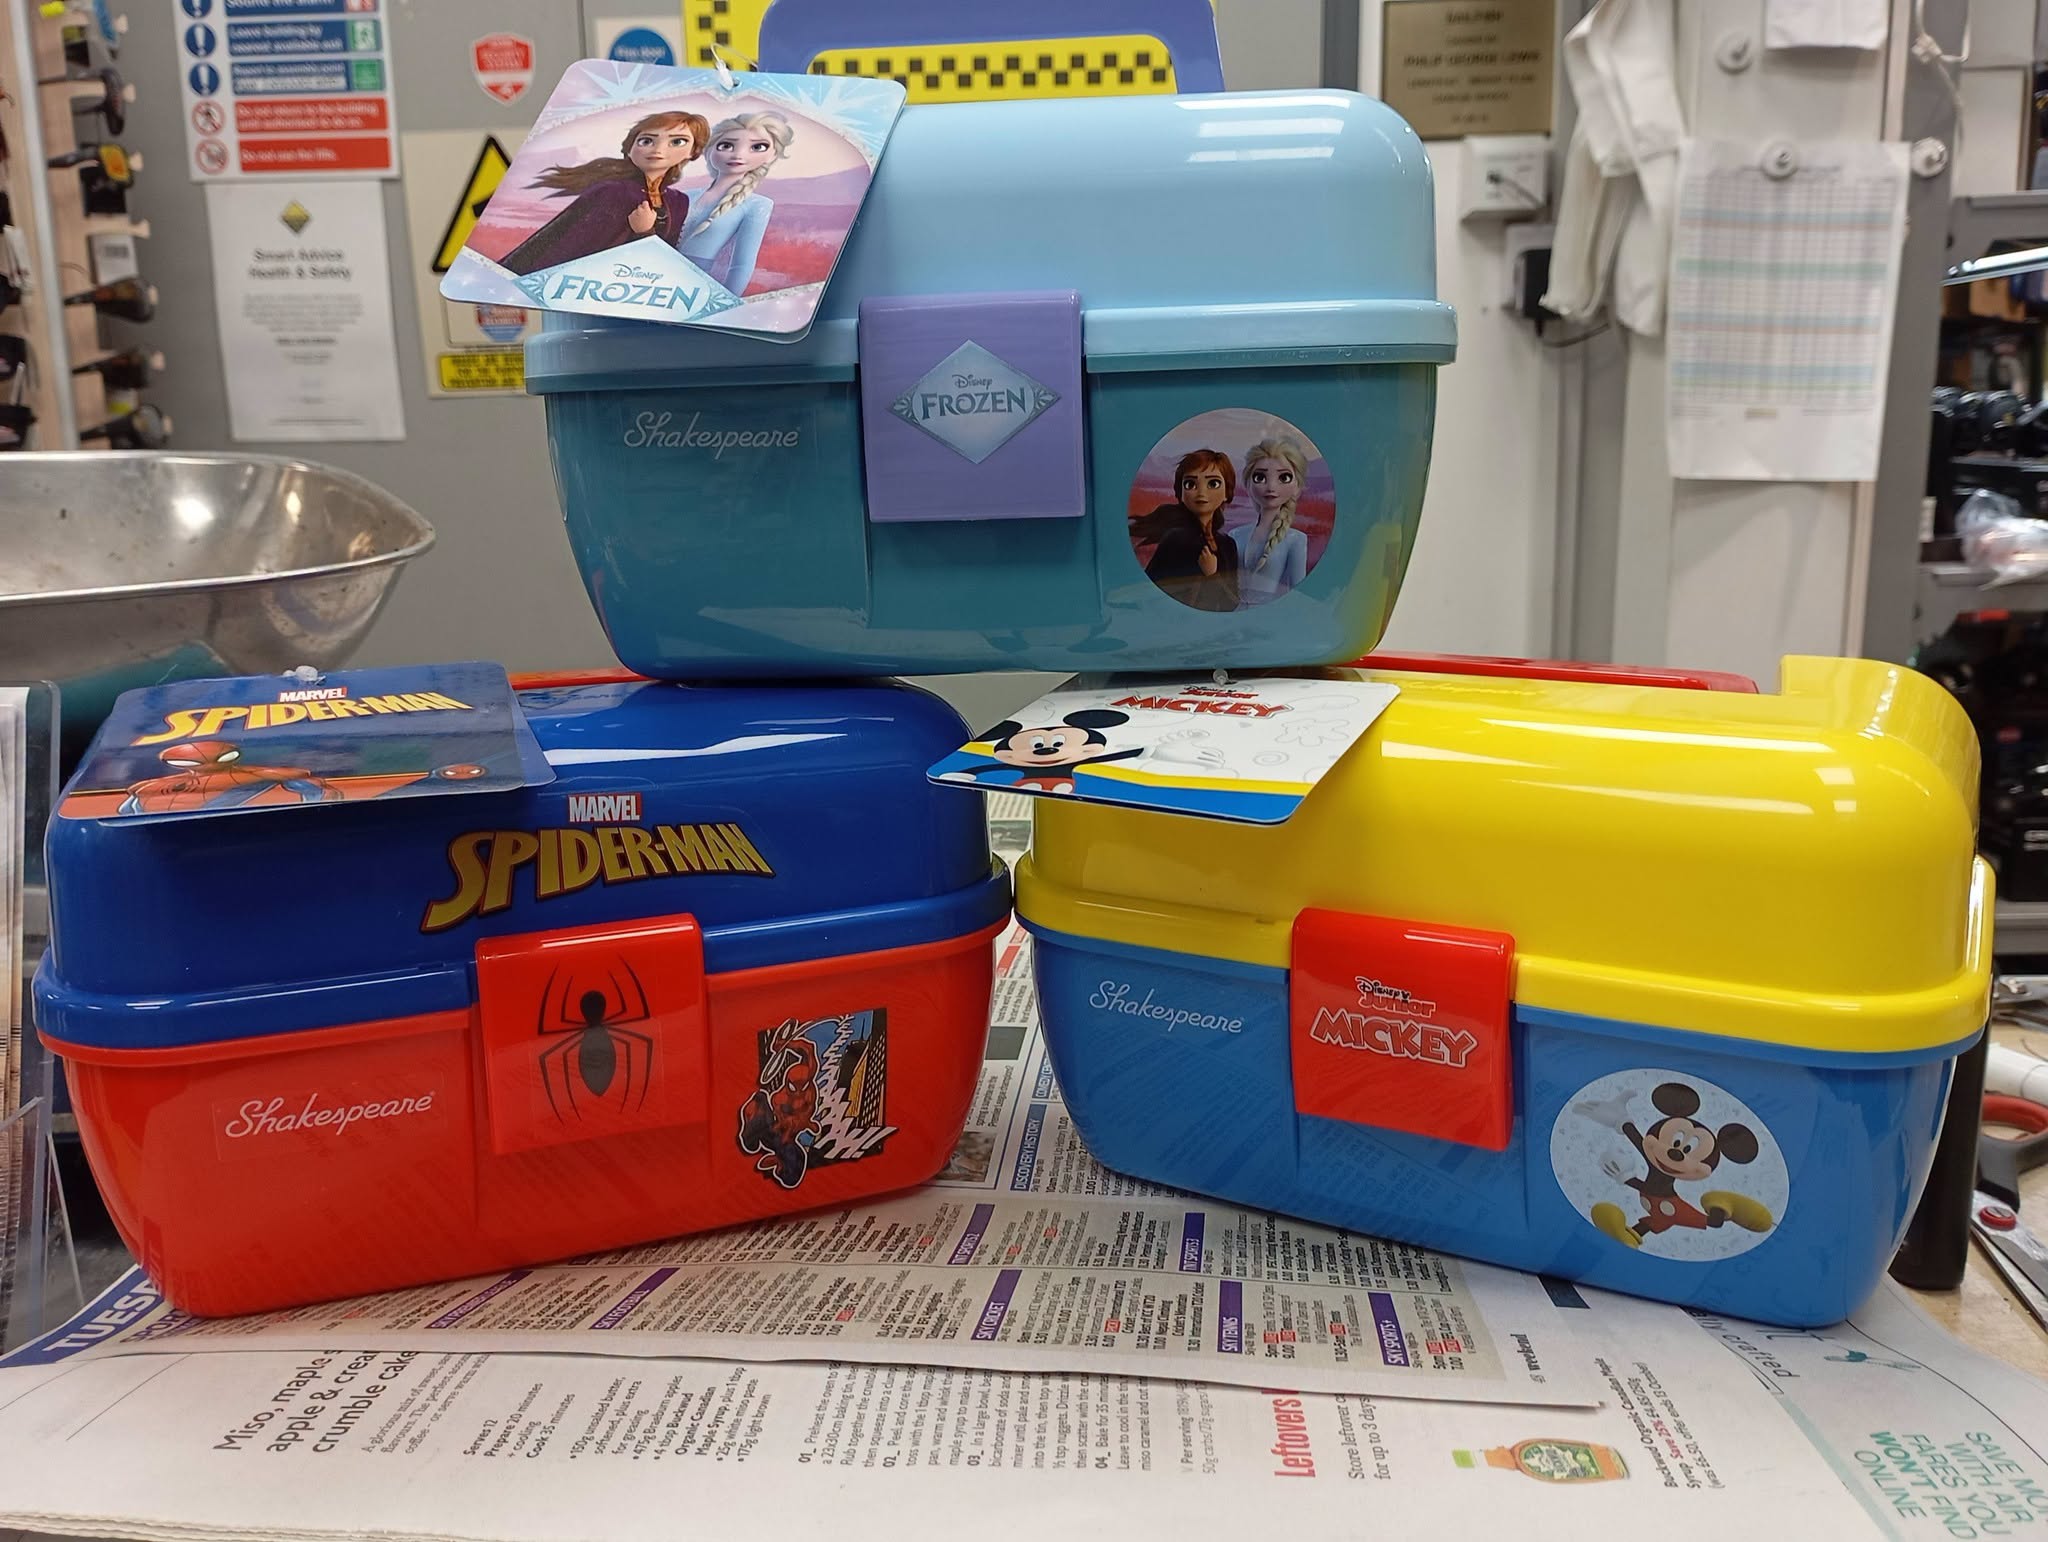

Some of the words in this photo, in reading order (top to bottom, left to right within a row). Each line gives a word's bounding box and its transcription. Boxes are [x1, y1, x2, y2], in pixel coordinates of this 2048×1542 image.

[254, 247, 293, 261] Smart
[249, 266, 290, 279] Health
[310, 266, 351, 281] Safety
[551, 275, 701, 313] FROZEN
[921, 386, 1027, 420] FROZEN
[624, 411, 799, 460] Shakespeare
[280, 687, 345, 703] MARVEL
[1110, 695, 1292, 718] MICKEY
[133, 692, 473, 747] SPIDER-MAN
[569, 794, 641, 822] MARVEL
[421, 823, 775, 932] SPIDER-MAN
[1089, 980, 1243, 1034] Shakespeare
[1310, 1008, 1478, 1068] MICKEY
[225, 1093, 434, 1138] Shakespeare
[1013, 1147, 1034, 1190] DISCOVERY
[1024, 1119, 1041, 1148] HISTORY
[982, 1302, 1005, 1326] CRICKET
[1222, 1317, 1238, 1337] TENNIS
[976, 1325, 995, 1339] SKY
[1222, 1337, 1238, 1351] SKY
[1386, 1348, 1404, 1364] SKY
[1594, 1358, 1614, 1377] Maple
[1723, 1333, 1801, 1379] crafted
[664, 1375, 683, 1398] apples
[743, 1379, 759, 1398] paste
[900, 1380, 914, 1391] the
[1608, 1378, 1635, 1410] Canadian
[213, 1406, 285, 1451] Miso,
[273, 1357, 333, 1403] maple
[312, 1385, 387, 1452] crumble
[378, 1350, 421, 1380] cake
[570, 1436, 595, 1453] 150g
[585, 1403, 610, 1435] unsalted
[600, 1377, 626, 1401] butter,
[666, 1393, 694, 1428] Buckwud
[695, 1429, 717, 1456] Maple
[707, 1404, 730, 1428] Syrup,
[720, 1387, 735, 1402] plus
[729, 1367, 747, 1382] tbsp
[735, 1399, 750, 1416] miso
[751, 1394, 771, 1418] brown
[804, 1413, 825, 1444] Preheat
[816, 1399, 830, 1411] the
[823, 1380, 835, 1397] oven
[899, 1393, 910, 1409] core
[1096, 1404, 1109, 1413] 35
[1354, 1396, 1376, 1421] days
[1660, 1399, 1680, 1418] ends
[266, 1405, 326, 1452] apple
[309, 1388, 343, 1400] &
[483, 1425, 515, 1457] Prepare
[506, 1413, 522, 1424] 20
[517, 1383, 543, 1412] minutes
[526, 1436, 549, 1458] Cook
[550, 1394, 575, 1424] minutes
[594, 1418, 623, 1454] softened,
[614, 1401, 631, 1416] plus
[625, 1381, 642, 1400] extra
[611, 1442, 628, 1454] for
[622, 1409, 650, 1441] greasing
[642, 1399, 670, 1434] Braeburn
[675, 1423, 700, 1455] Organic
[690, 1387, 716, 1421] Canadian
[725, 1418, 742, 1439] white
[744, 1419, 763, 1437] light
[894, 1411, 907, 1426] and
[1095, 1414, 1108, 1427] for
[1337, 1405, 1357, 1446] leftover
[1628, 1411, 1654, 1444] Organic
[1673, 1419, 1693, 1439] offer
[463, 1429, 491, 1455] Serves
[483, 1419, 498, 1427] 12
[513, 1421, 542, 1451] cooling
[633, 1435, 656, 1454] 475g
[658, 1429, 678, 1447] tbsp
[715, 1441, 737, 1456] 25g
[887, 1427, 903, 1446] Peel
[1095, 1428, 1108, 1447] Bake
[1271, 1399, 1316, 1477] Leftovers
[1368, 1432, 1381, 1443] to
[1665, 1438, 1684, 1459] Save
[1347, 1448, 1365, 1479] Store
[1372, 1446, 1389, 1460] up
[1644, 1446, 1678, 1487] Buckwud
[1965, 1431, 2025, 1474] SAVE
[1373, 1462, 1391, 1479] for
[1679, 1463, 1702, 1489] Syrup
[1854, 1449, 1929, 1519] ONLINE
[1869, 1431, 1939, 1490] WON'T
[1921, 1495, 1978, 1540] FIND
[1903, 1433, 1968, 1489] FARES
[1959, 1493, 2013, 1536] YOU
[1945, 1442, 2001, 1487] WITH
[1993, 1491, 2034, 1524] AIR
